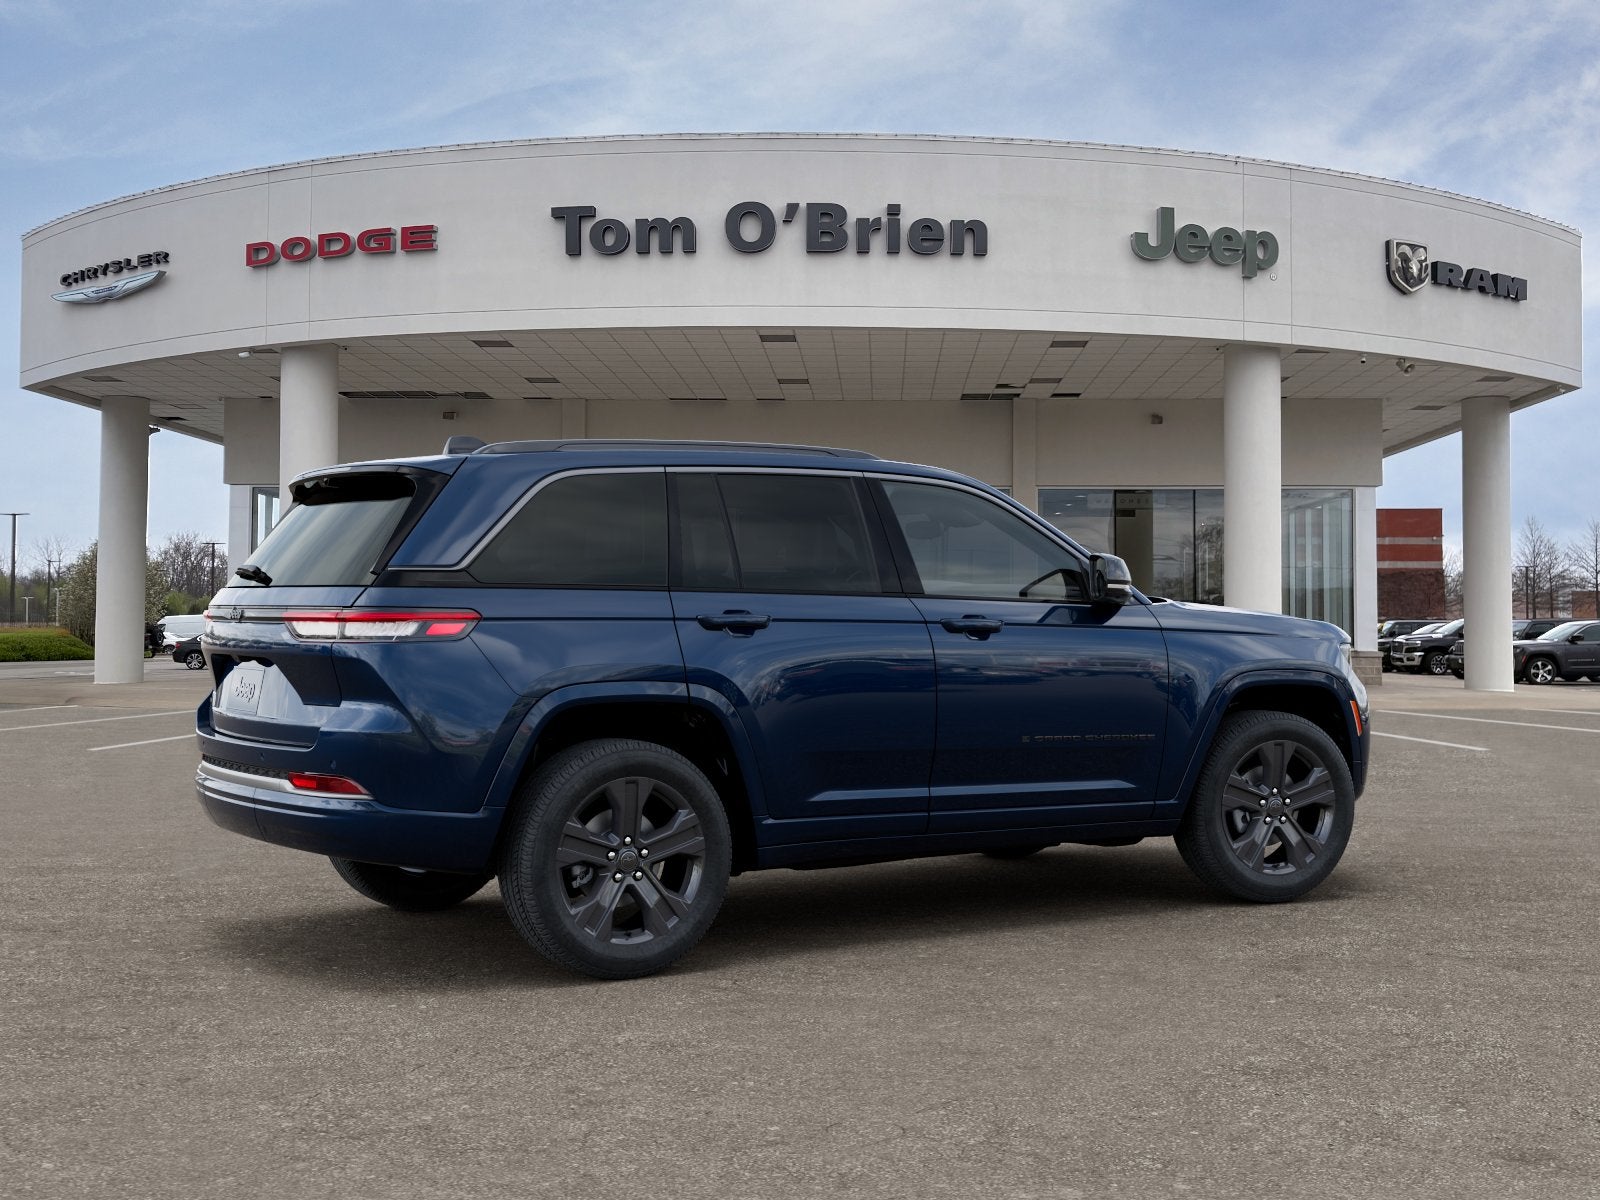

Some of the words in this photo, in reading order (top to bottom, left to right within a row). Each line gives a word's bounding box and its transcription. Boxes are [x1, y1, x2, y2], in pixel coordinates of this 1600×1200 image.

[245, 224, 439, 268] DODGE
[551, 205, 697, 256] Tom
[725, 201, 988, 256] O'Brien
[1130, 206, 1280, 279] Jeep
[60, 250, 170, 287] CHRYSLER
[1431, 261, 1528, 301] RAM
